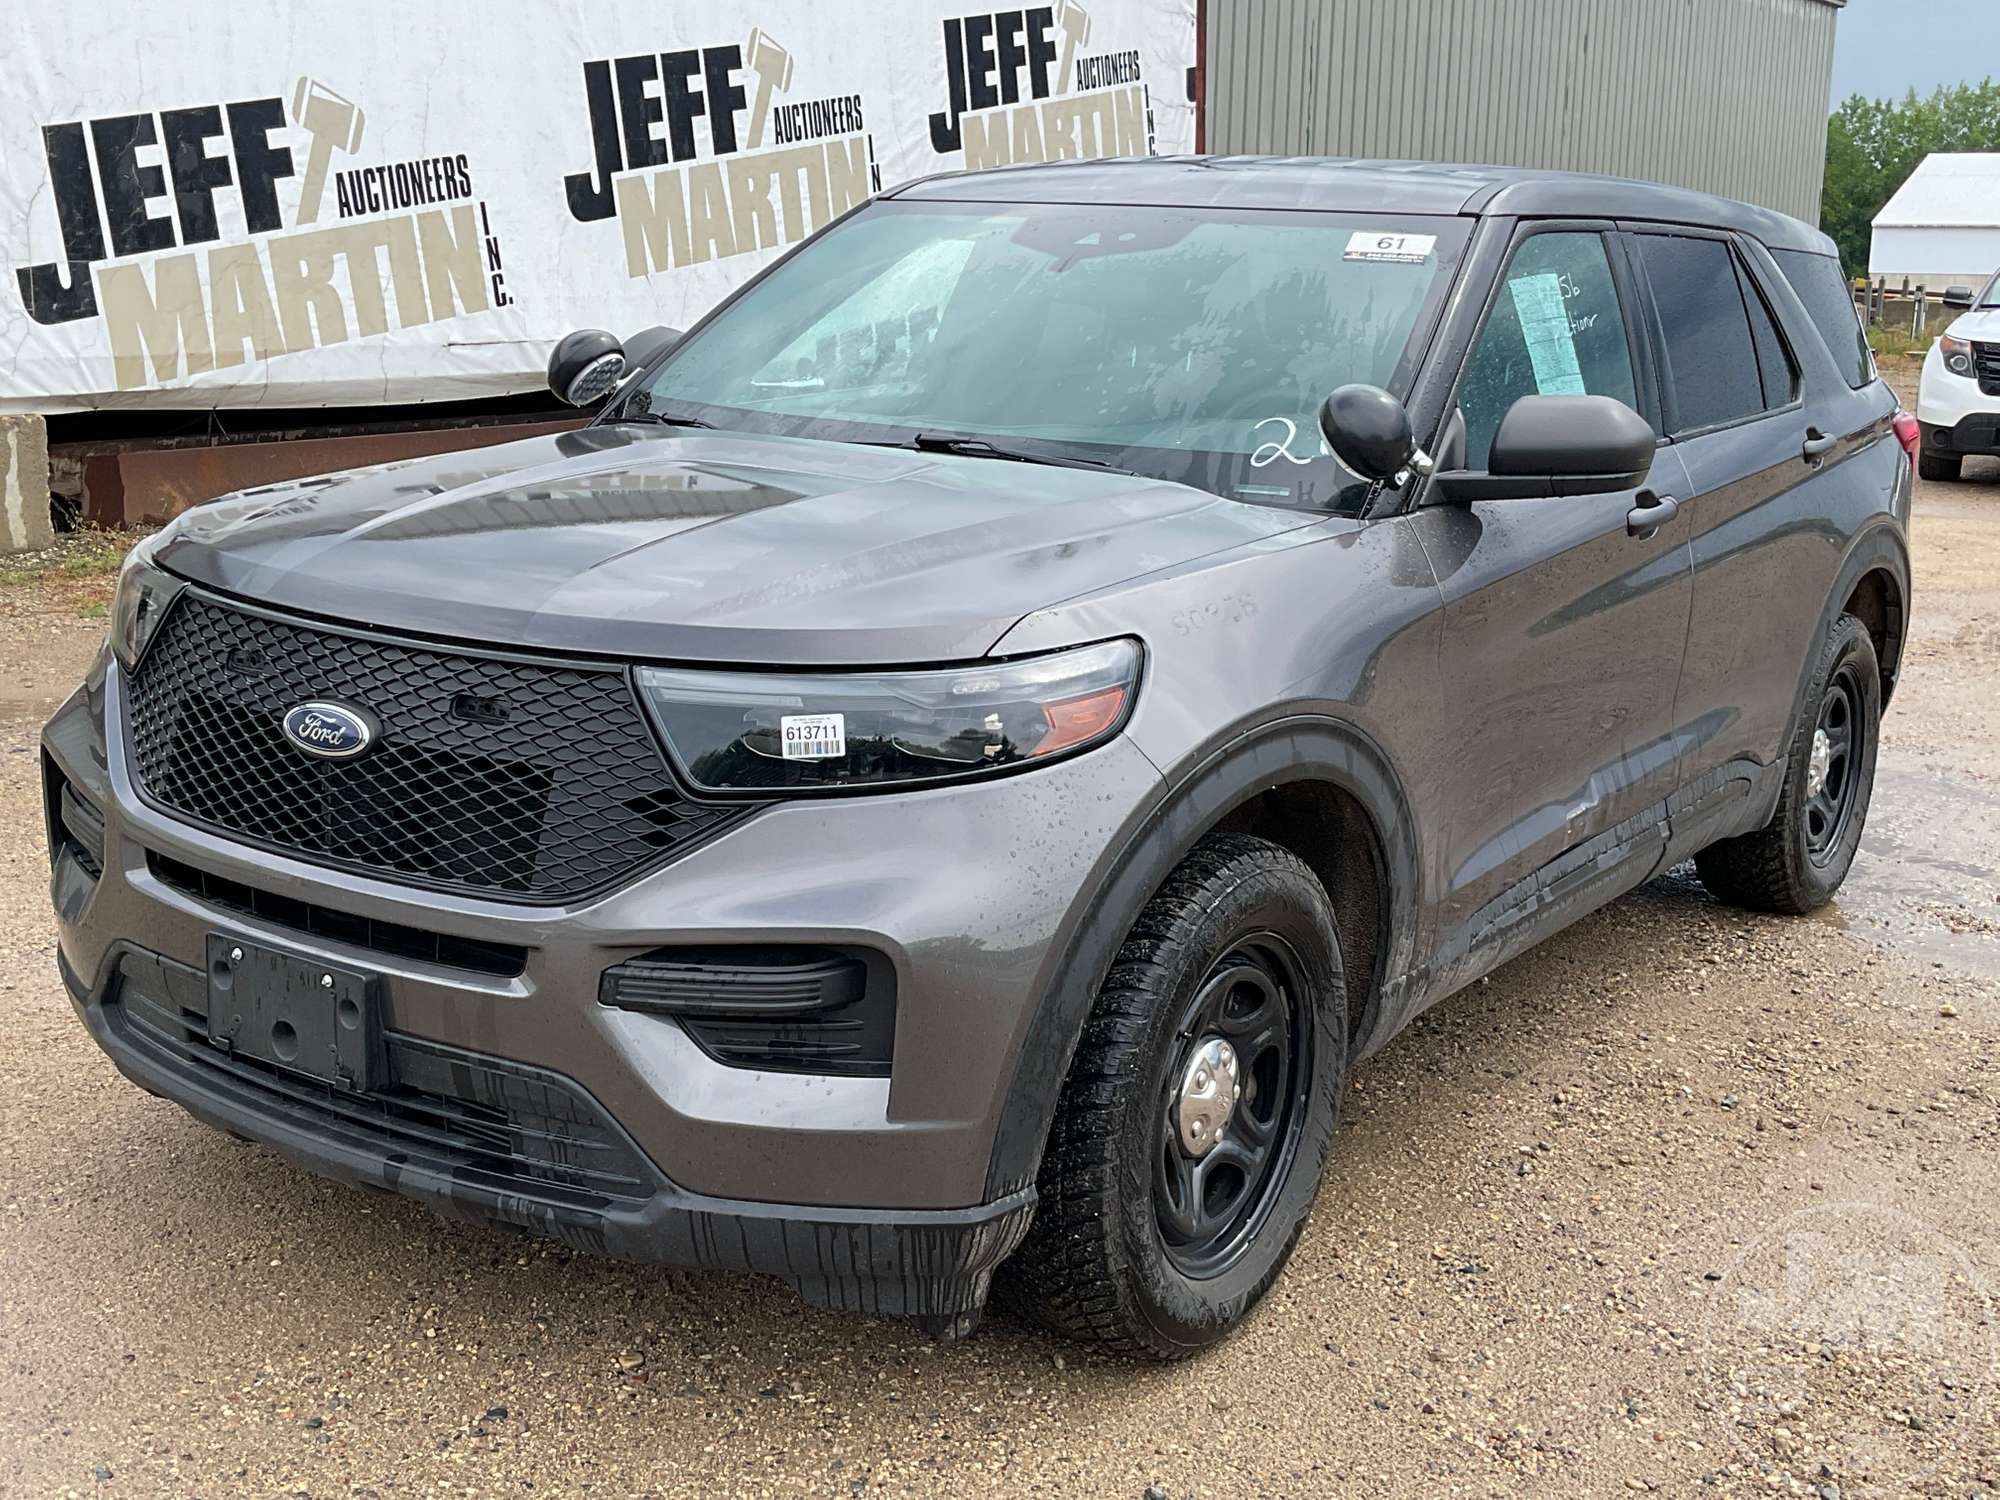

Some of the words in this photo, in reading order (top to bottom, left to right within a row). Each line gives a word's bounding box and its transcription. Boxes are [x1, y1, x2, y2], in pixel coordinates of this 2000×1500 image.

[929, 6, 1056, 154] JEFF
[1076, 49, 1141, 92] AUCTIONEERS
[563, 44, 747, 223] JEFF
[773, 94, 864, 145] AUCTIONEERS
[962, 85, 1146, 171] MARTIN
[15, 96, 295, 326] JEFF
[335, 153, 472, 219] AUCTIONEERS
[616, 136, 870, 280] MARTIN
[1376, 236, 1406, 251] 61
[97, 204, 490, 392] MARTIN
[298, 712, 347, 745] Ford
[786, 724, 838, 741] 613711
